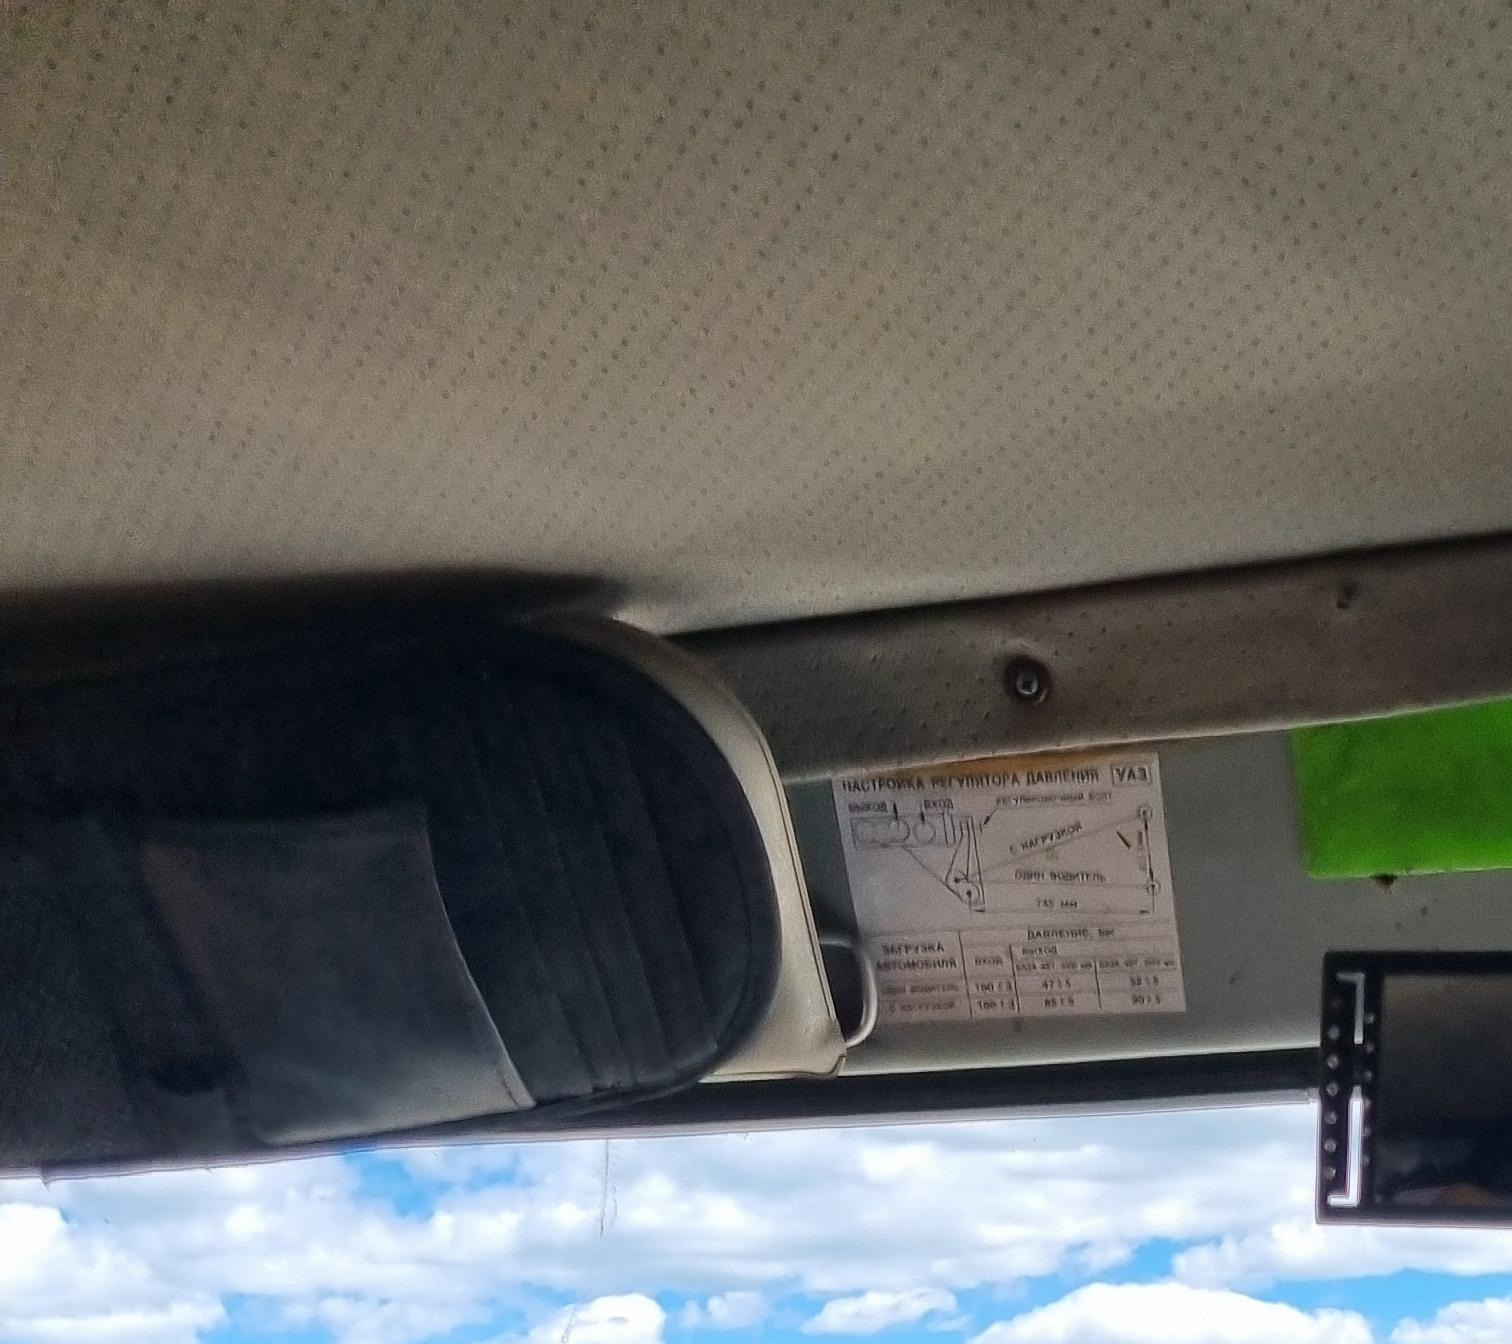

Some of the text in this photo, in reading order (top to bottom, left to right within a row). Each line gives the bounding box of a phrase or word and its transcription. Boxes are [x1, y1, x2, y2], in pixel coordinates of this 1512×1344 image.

[842, 776, 925, 792] НАСТРОЙКА
[1026, 767, 1099, 785] ДАВЛЕНИЯ
[1114, 766, 1149, 783] УАЗ
